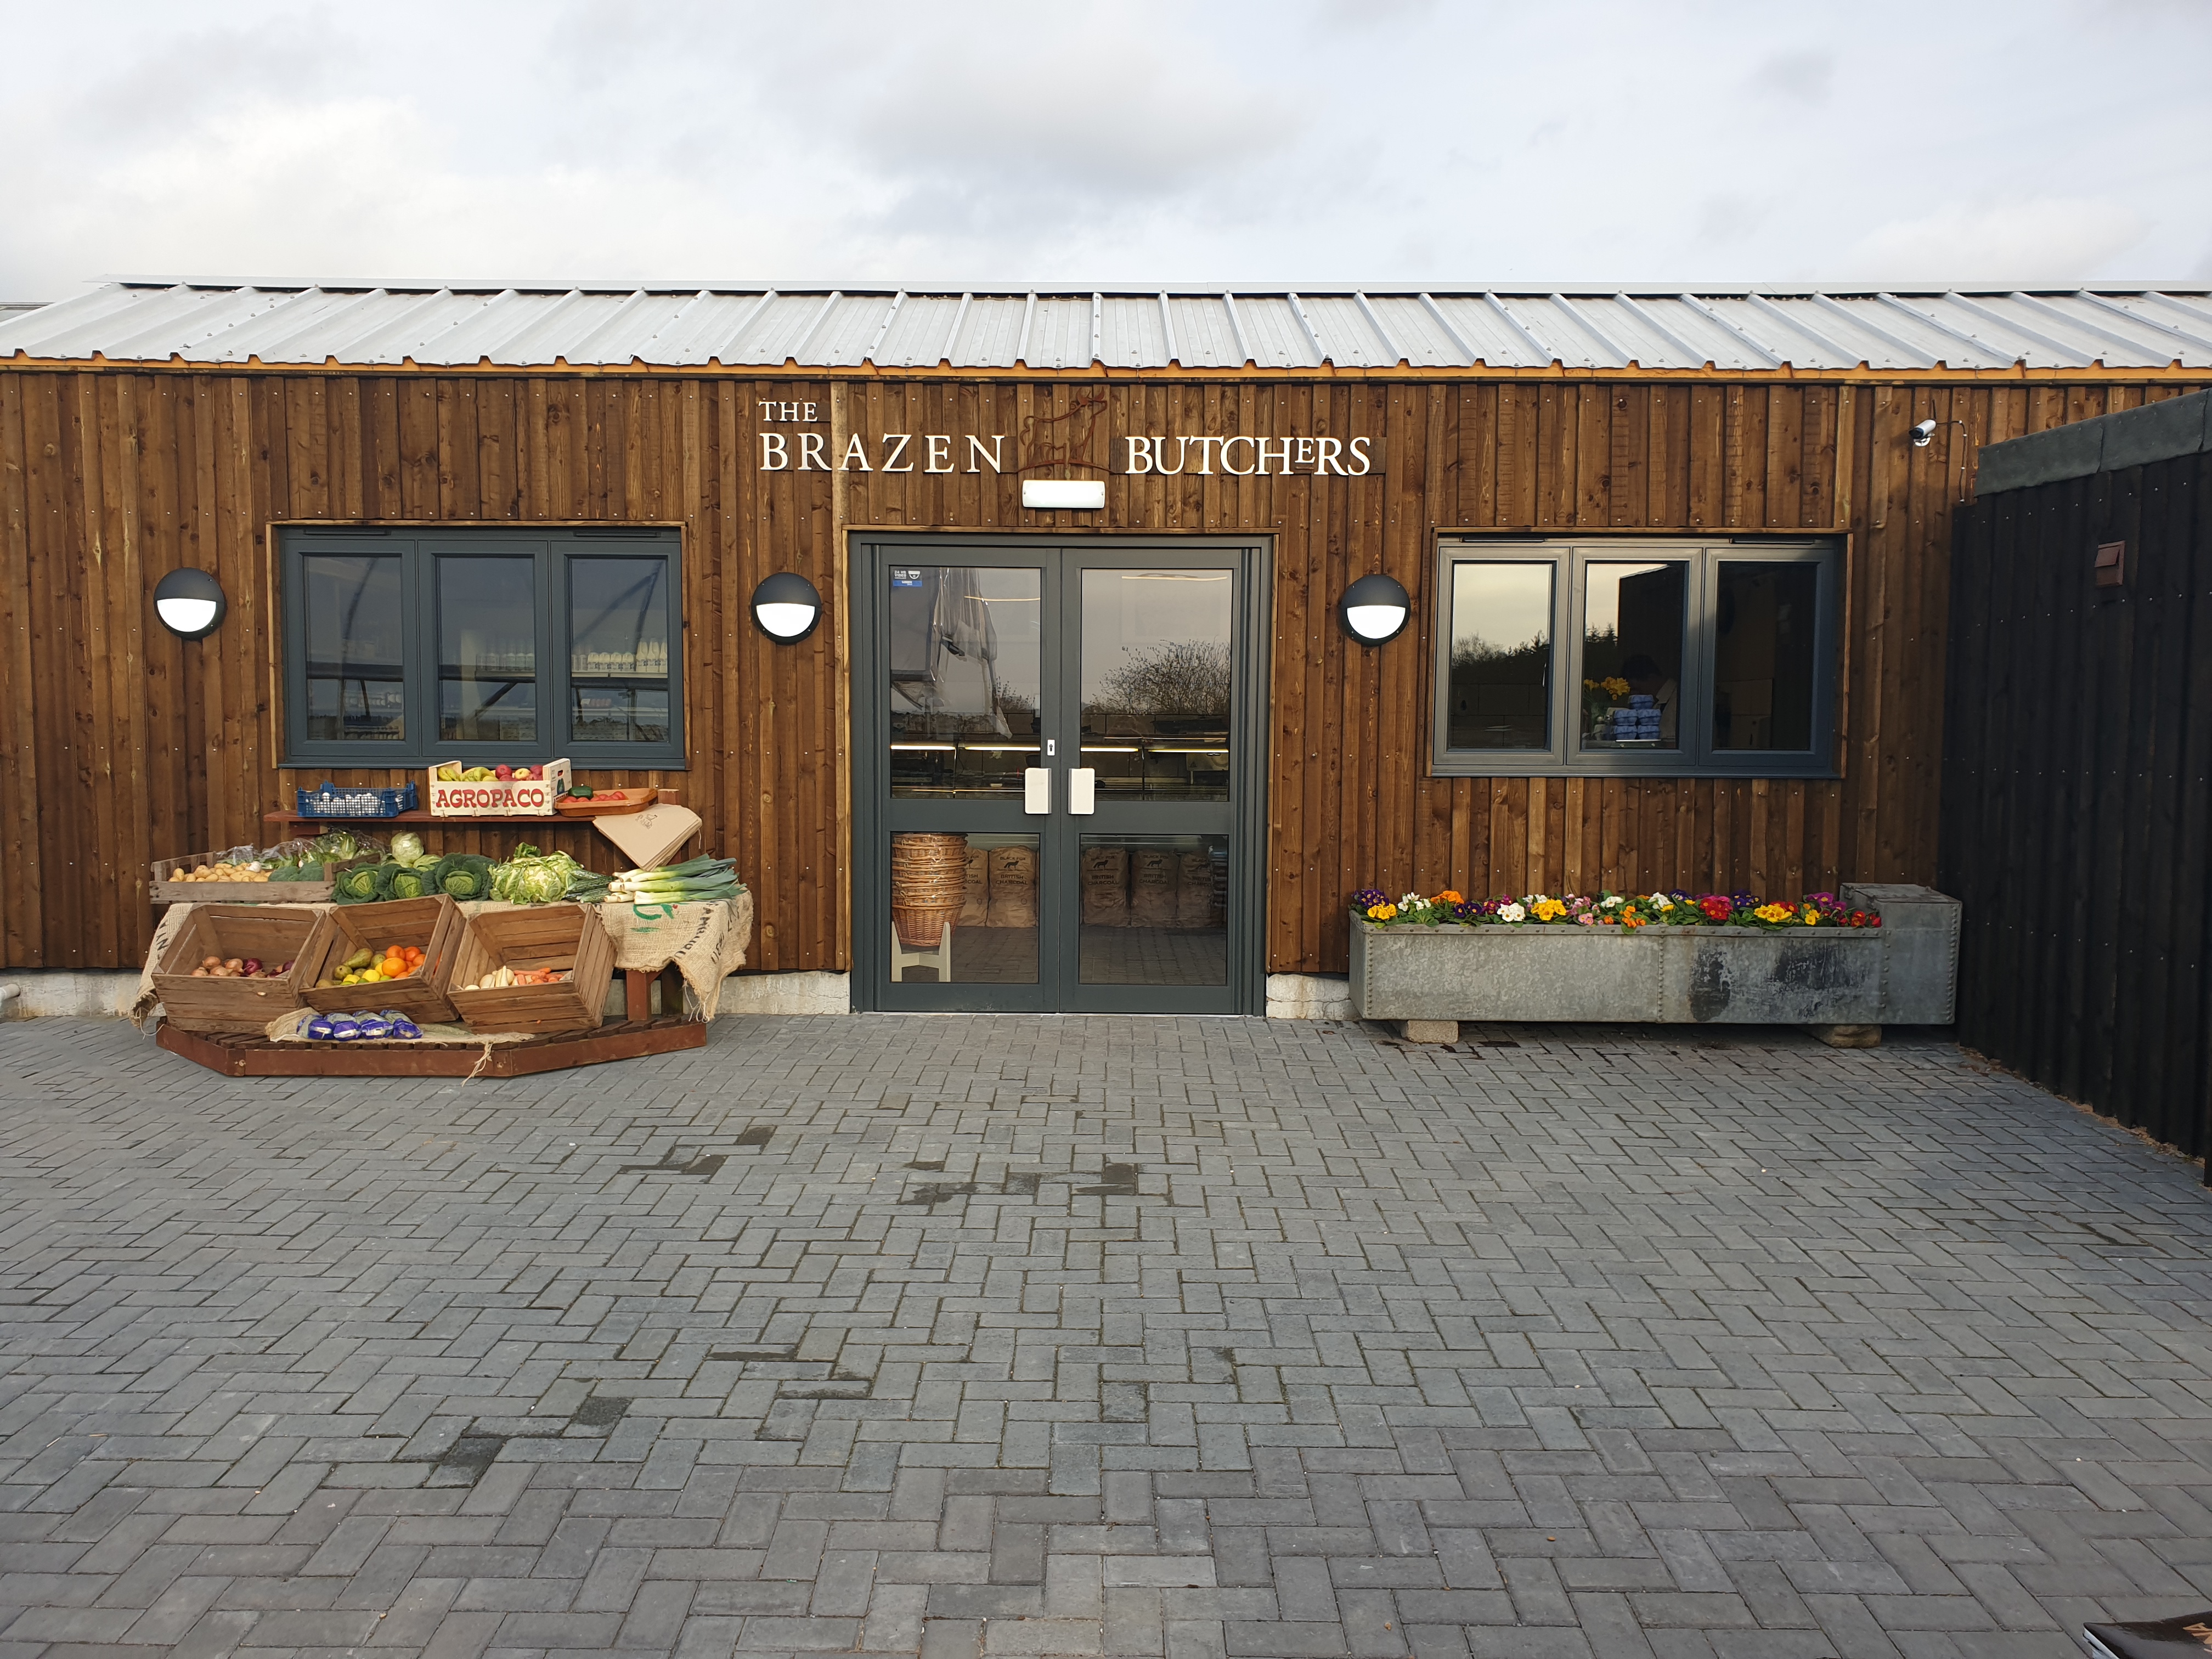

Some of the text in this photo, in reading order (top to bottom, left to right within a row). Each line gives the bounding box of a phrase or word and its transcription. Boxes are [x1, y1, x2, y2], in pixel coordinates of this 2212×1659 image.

[758, 400, 819, 422] THE
[759, 432, 1370, 476] BRAZEN BUTCHERS
[436, 788, 545, 809] AGROPACO
